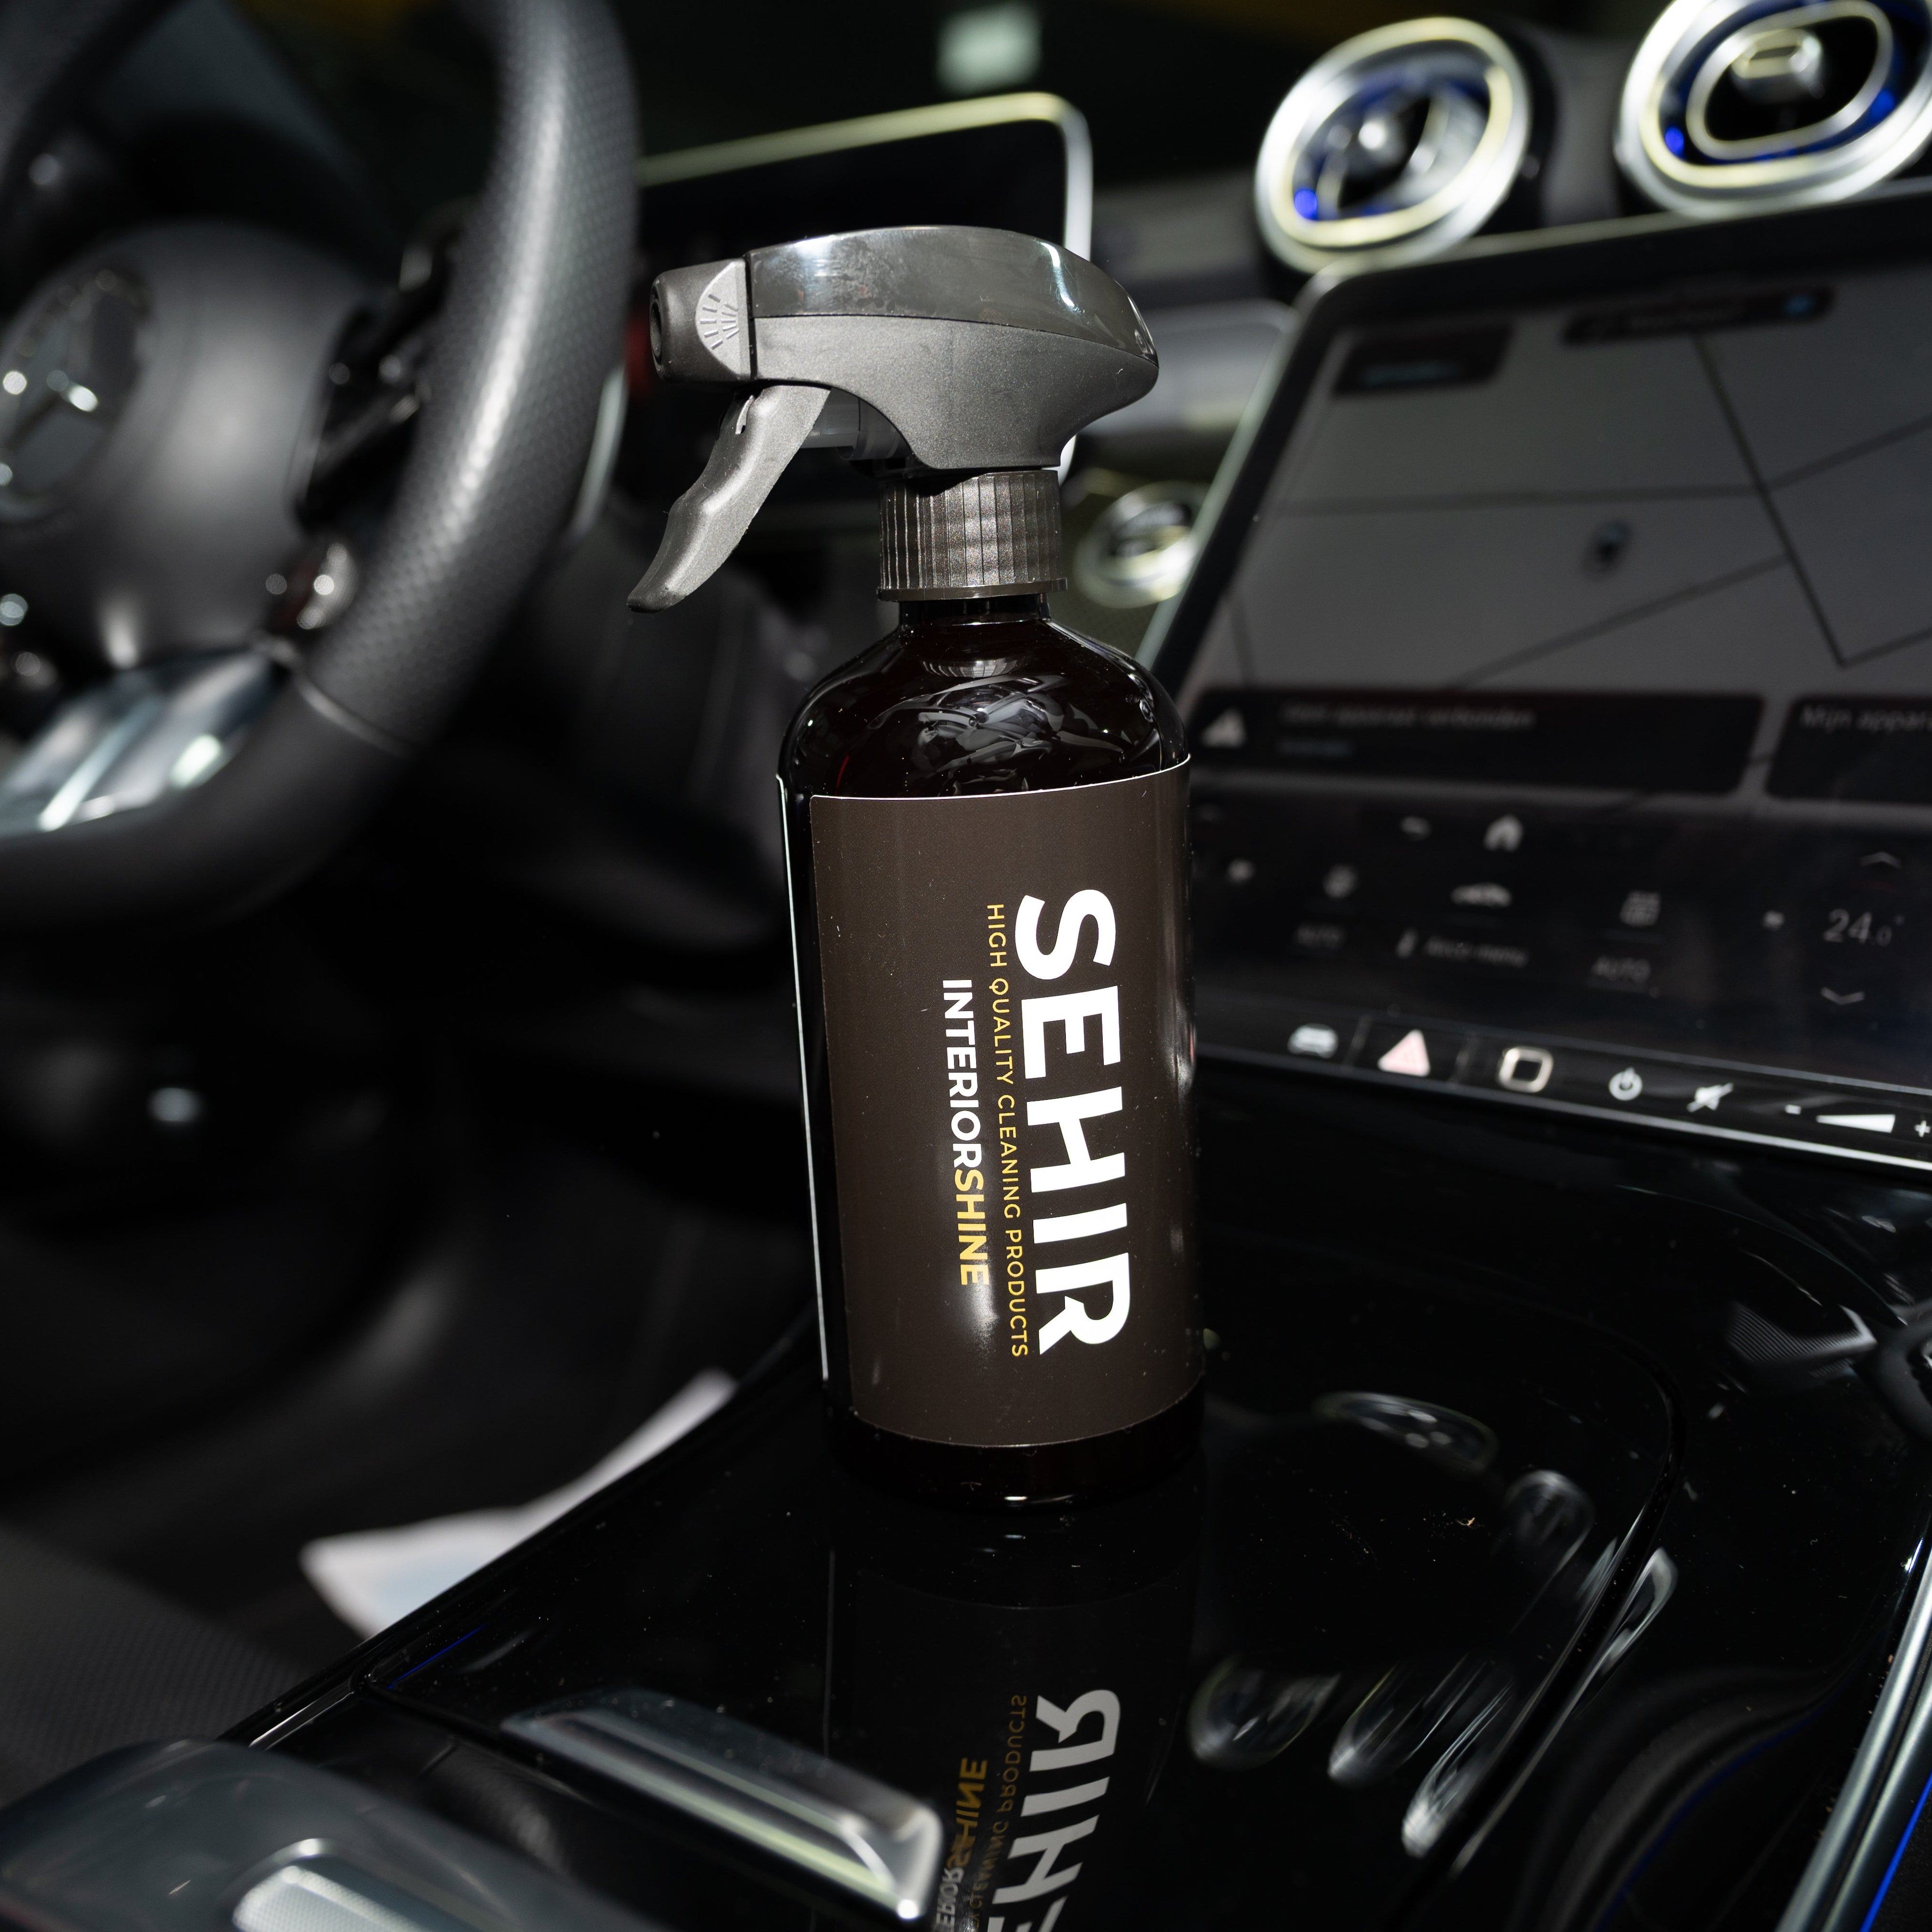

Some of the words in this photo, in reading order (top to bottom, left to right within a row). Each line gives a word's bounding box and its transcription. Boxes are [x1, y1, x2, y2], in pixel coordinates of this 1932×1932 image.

[1801, 704, 1852, 735] Mijn
[987, 904, 1008, 967] HIGH
[989, 977, 1014, 1085] QUALITY
[942, 979, 990, 1286] INTERIORSHINE
[997, 1094, 1021, 1219] CLEANING
[1014, 889, 1131, 1355] SEHIR
[1005, 1229, 1029, 1357] PRODUCTS
